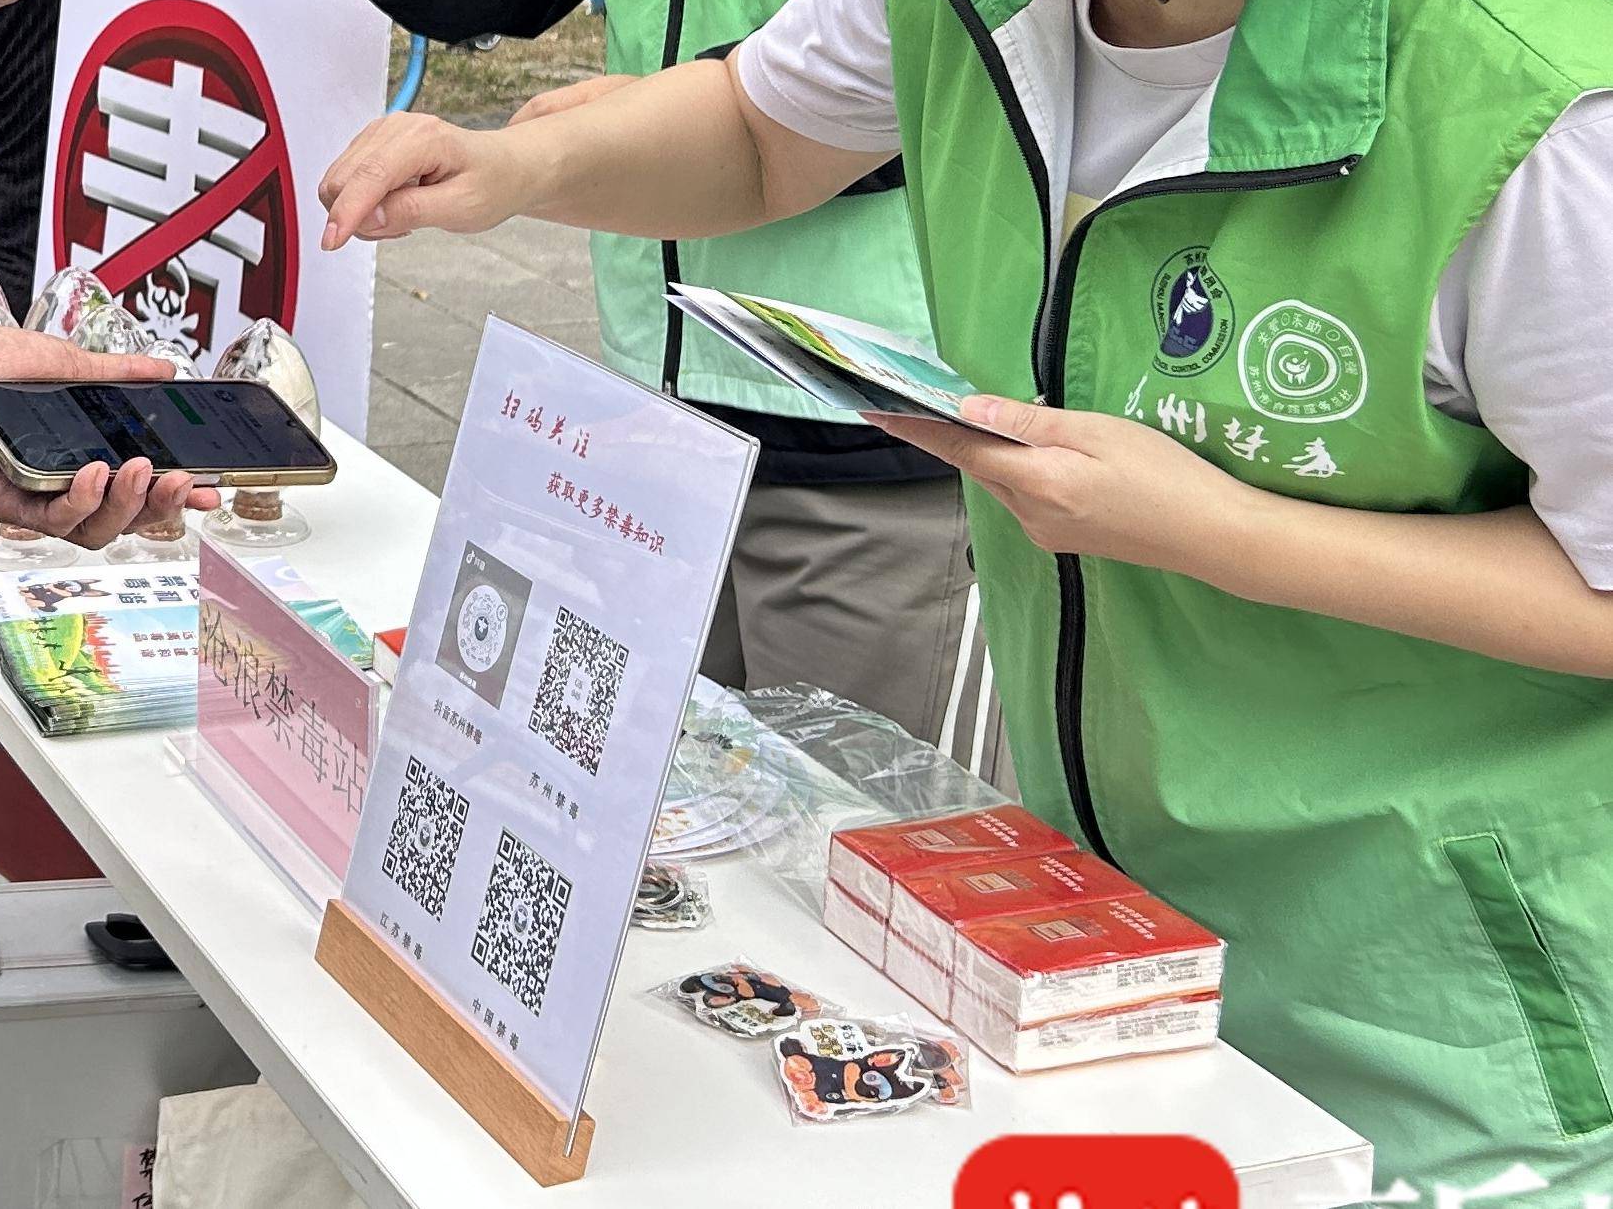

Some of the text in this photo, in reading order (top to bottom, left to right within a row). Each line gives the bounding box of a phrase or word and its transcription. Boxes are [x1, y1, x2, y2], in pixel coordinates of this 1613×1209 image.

[500, 389, 590, 459] 扫码关注
[546, 471, 665, 556] 获取更多禁毒知识
